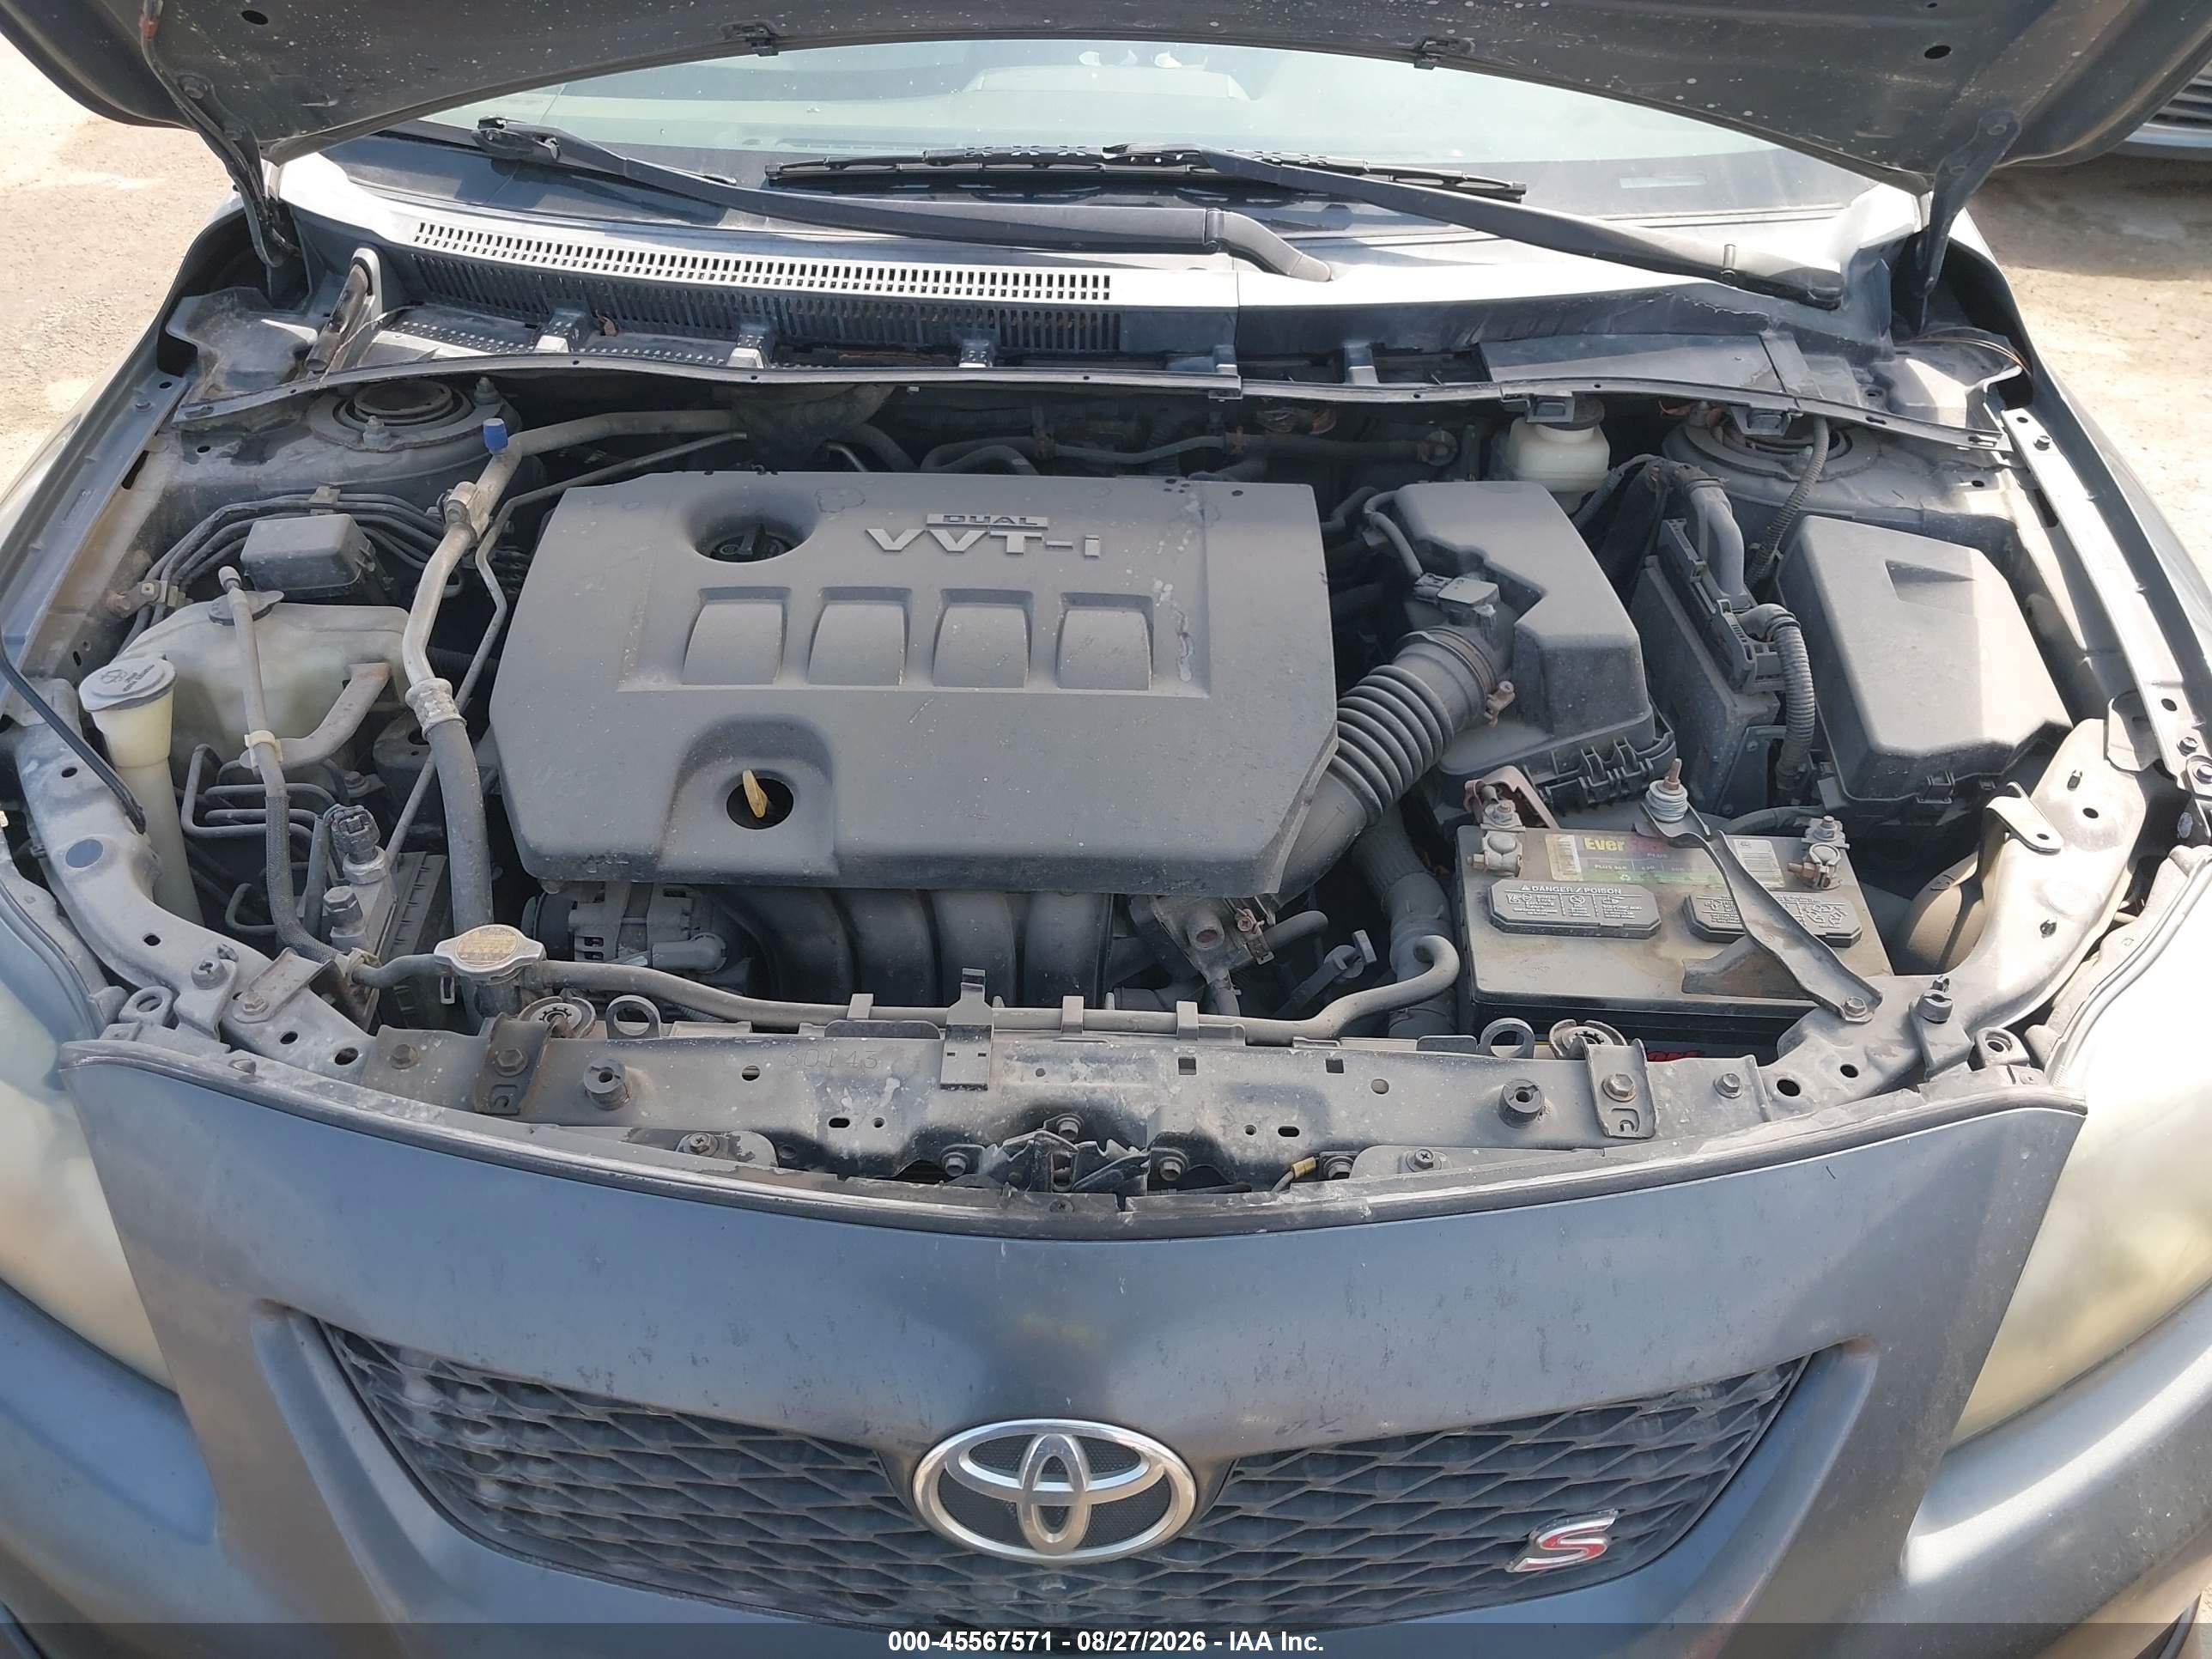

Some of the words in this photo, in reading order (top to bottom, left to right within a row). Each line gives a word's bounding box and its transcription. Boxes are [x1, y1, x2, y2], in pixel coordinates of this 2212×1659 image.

[943, 515, 1038, 526] DUAL
[865, 528, 1101, 558] VVT-i
[784, 1048, 878, 1069] 60143
[1510, 1515, 1617, 1573] S
